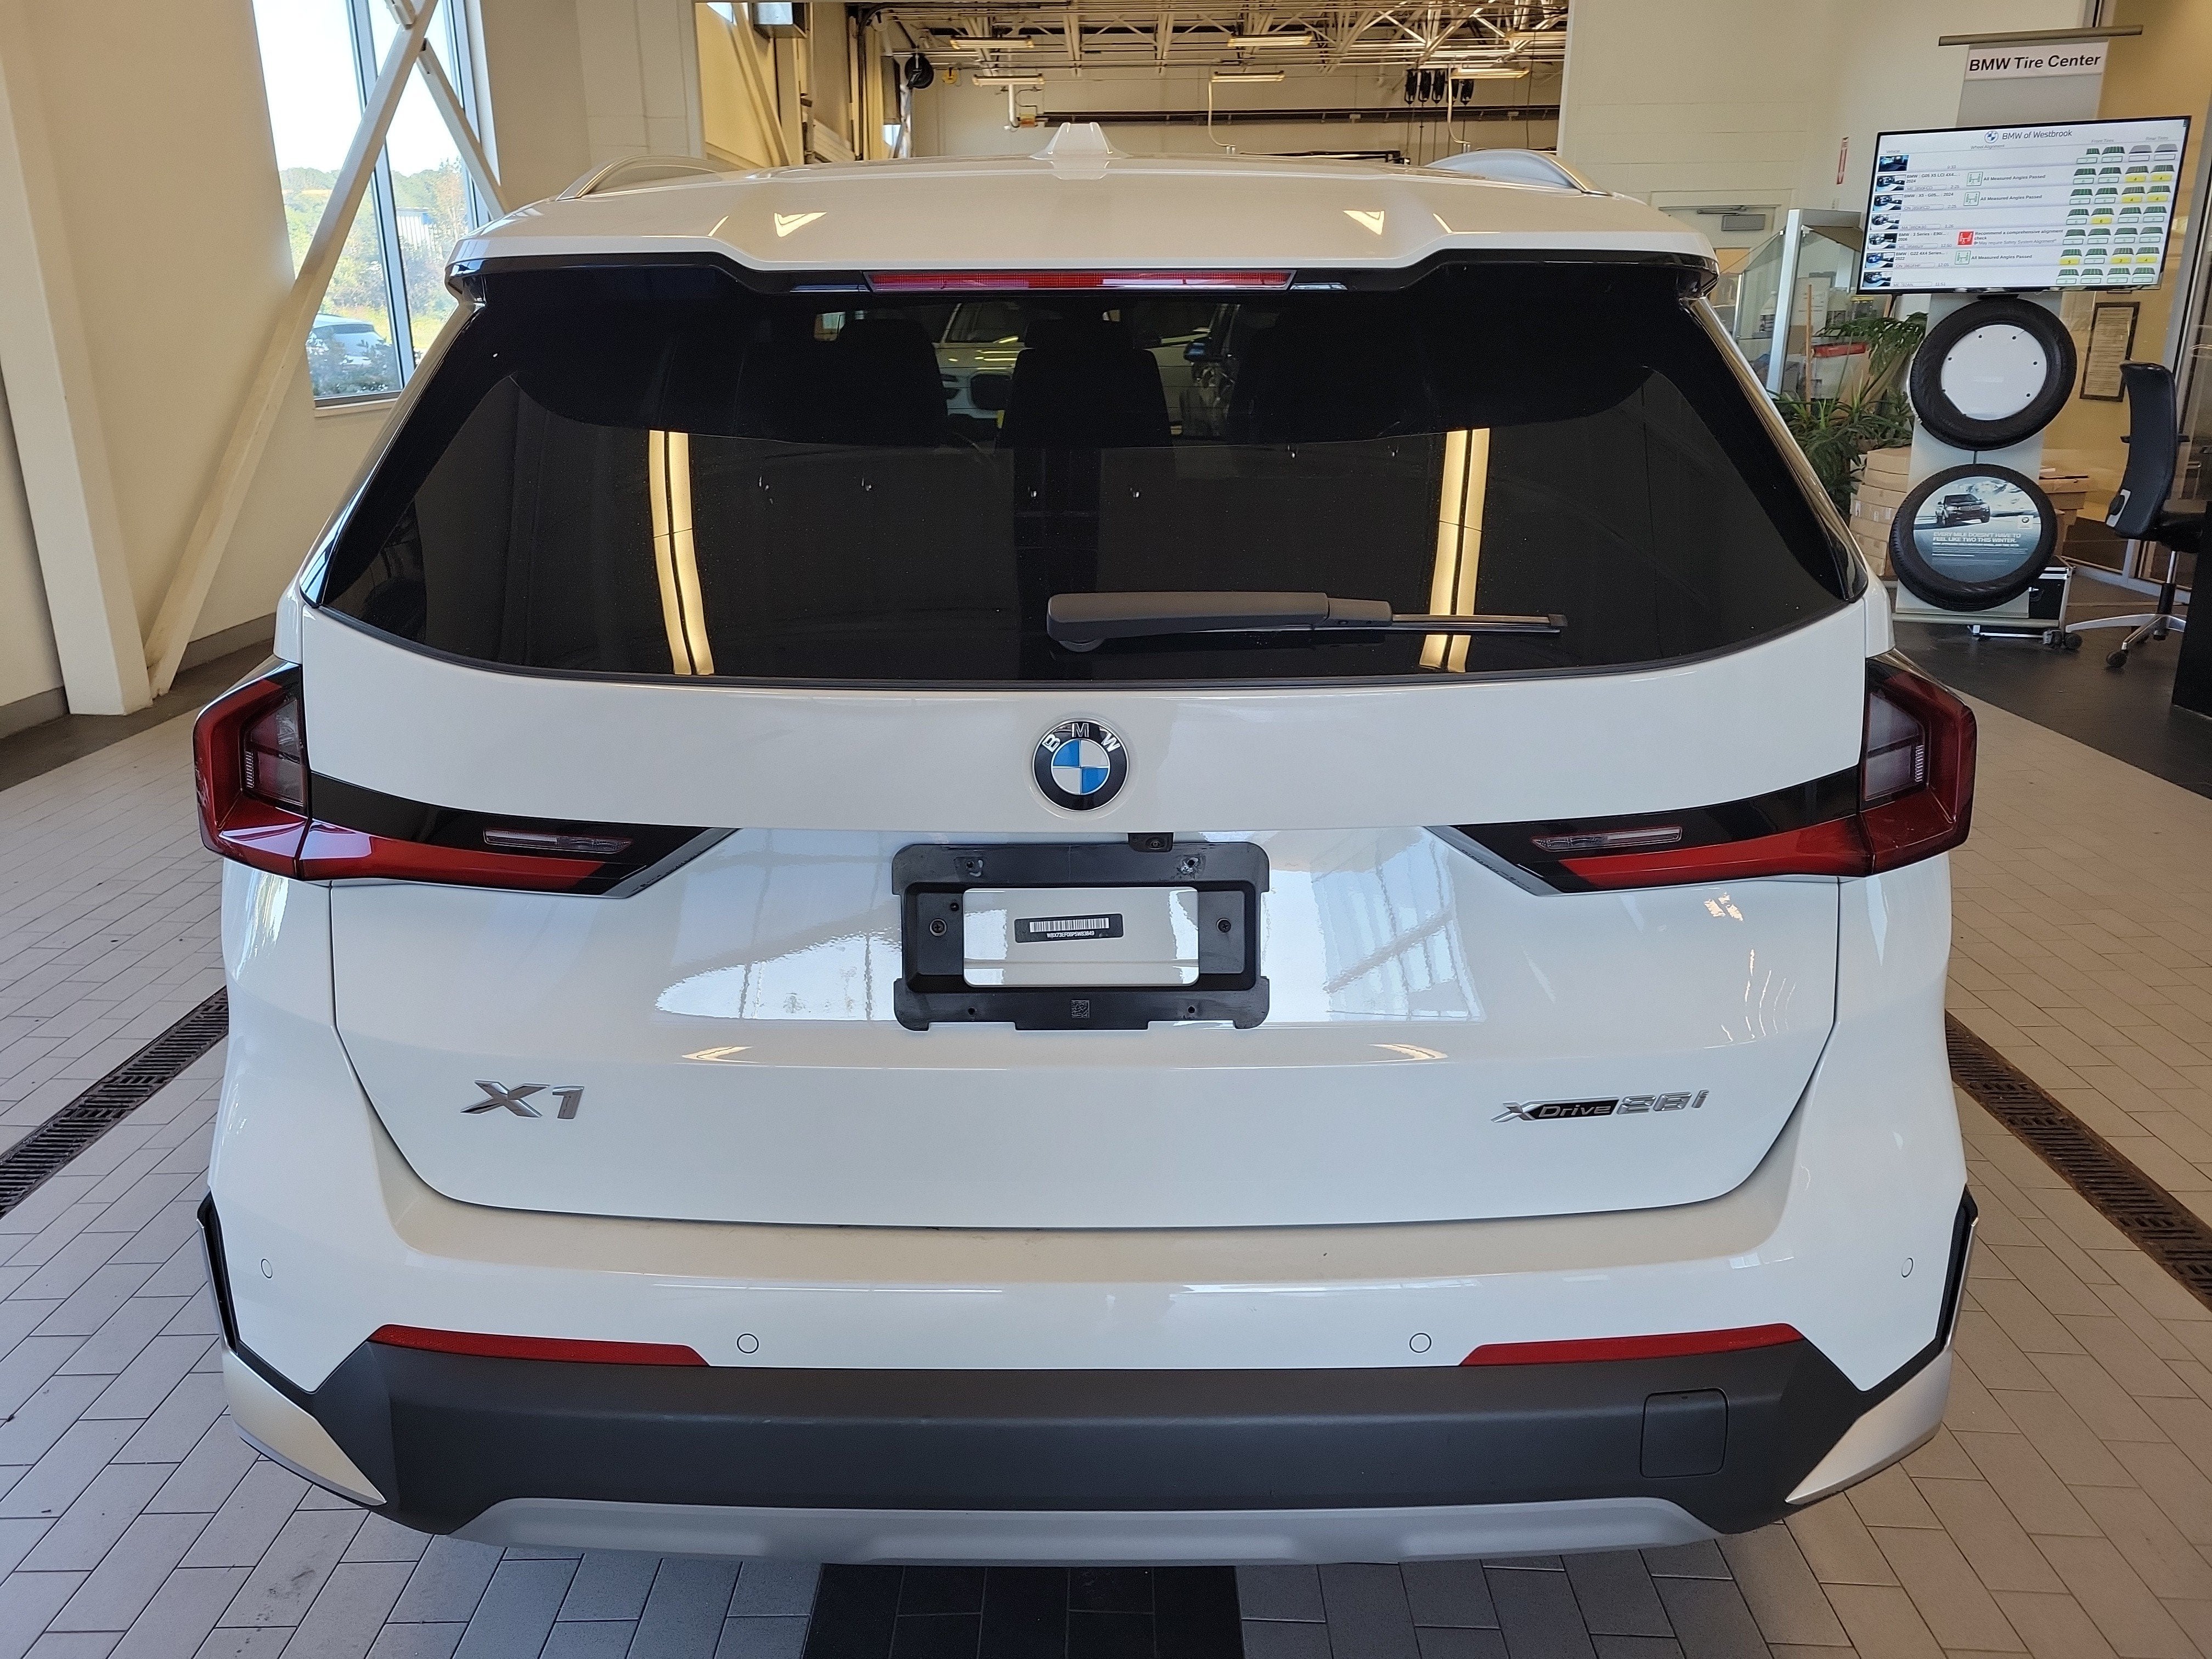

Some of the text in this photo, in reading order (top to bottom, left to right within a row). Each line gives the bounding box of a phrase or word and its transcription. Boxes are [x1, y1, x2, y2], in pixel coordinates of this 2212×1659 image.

[1969, 54, 2101, 71] BMW Tire Center
[2033, 129, 2073, 138] Westbrook
[1041, 722, 1121, 753] BMW
[460, 1080, 585, 1120] X1
